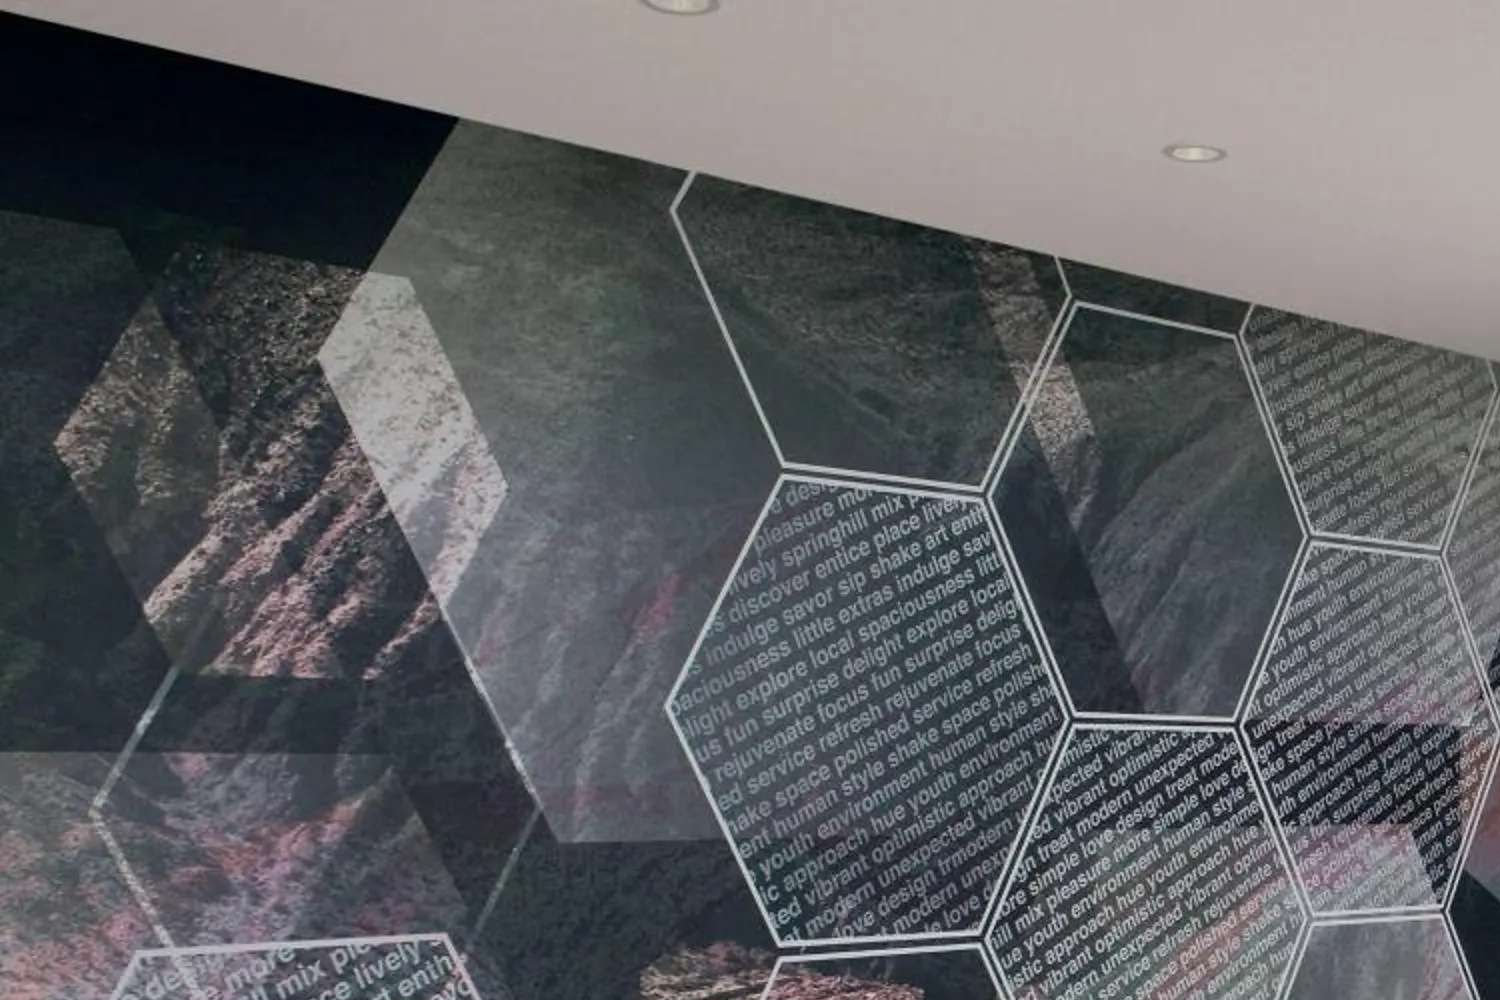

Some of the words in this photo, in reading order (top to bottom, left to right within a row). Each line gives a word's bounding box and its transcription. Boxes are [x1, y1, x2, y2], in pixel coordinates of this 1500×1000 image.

[702, 616, 780, 667] indulge
[781, 585, 834, 626] savor
[837, 570, 867, 596] sip
[868, 541, 922, 580] shake
[923, 523, 949, 550] art
[728, 569, 809, 623] discover
[814, 540, 870, 579] entice
[871, 514, 921, 554] place
[751, 501, 834, 558] pleasure
[780, 507, 869, 567] springhill
[869, 493, 905, 523] mix
[791, 616, 836, 649] little
[837, 584, 894, 624] extras
[894, 549, 960, 594] indulge
[712, 715, 815, 784] rejuvenate
[815, 683, 870, 724] focus
[869, 664, 903, 692] fun
[903, 623, 974, 673] surprise
[722, 717, 760, 747] fun
[761, 672, 840, 726] surprise
[841, 632, 904, 680] delight
[906, 599, 969, 643] explore
[968, 570, 1011, 607] local
[735, 660, 808, 710] explore
[807, 628, 856, 669] local
[857, 568, 975, 642] spaciousness
[745, 743, 816, 794] service
[816, 702, 884, 753] refresh
[884, 651, 973, 713] rejuvenate
[974, 623, 1021, 659] focus
[757, 831, 815, 882] youth
[816, 758, 928, 840] environment
[927, 725, 987, 771] human
[988, 699, 1028, 733] style
[771, 788, 840, 839] human
[840, 760, 885, 796] style
[886, 726, 939, 768] shake
[940, 695, 991, 734] space
[773, 764, 831, 807] space
[832, 711, 911, 778] polished
[911, 679, 973, 725] service
[974, 641, 1032, 687] refresh
[781, 825, 870, 892] approach
[869, 804, 906, 836] hue
[906, 769, 957, 817] youth
[959, 704, 1058, 778] environment
[802, 852, 870, 906] vibrant
[871, 800, 955, 863] optimistic
[957, 748, 1033, 808] approach
[803, 880, 876, 937] modern
[877, 809, 976, 888] unexpected
[976, 772, 1035, 821] vibrant
[351, 937, 420, 989] lively
[876, 868, 936, 916] design
[891, 881, 959, 936] modern
[941, 894, 980, 928] love
[274, 958, 328, 1000] mix
